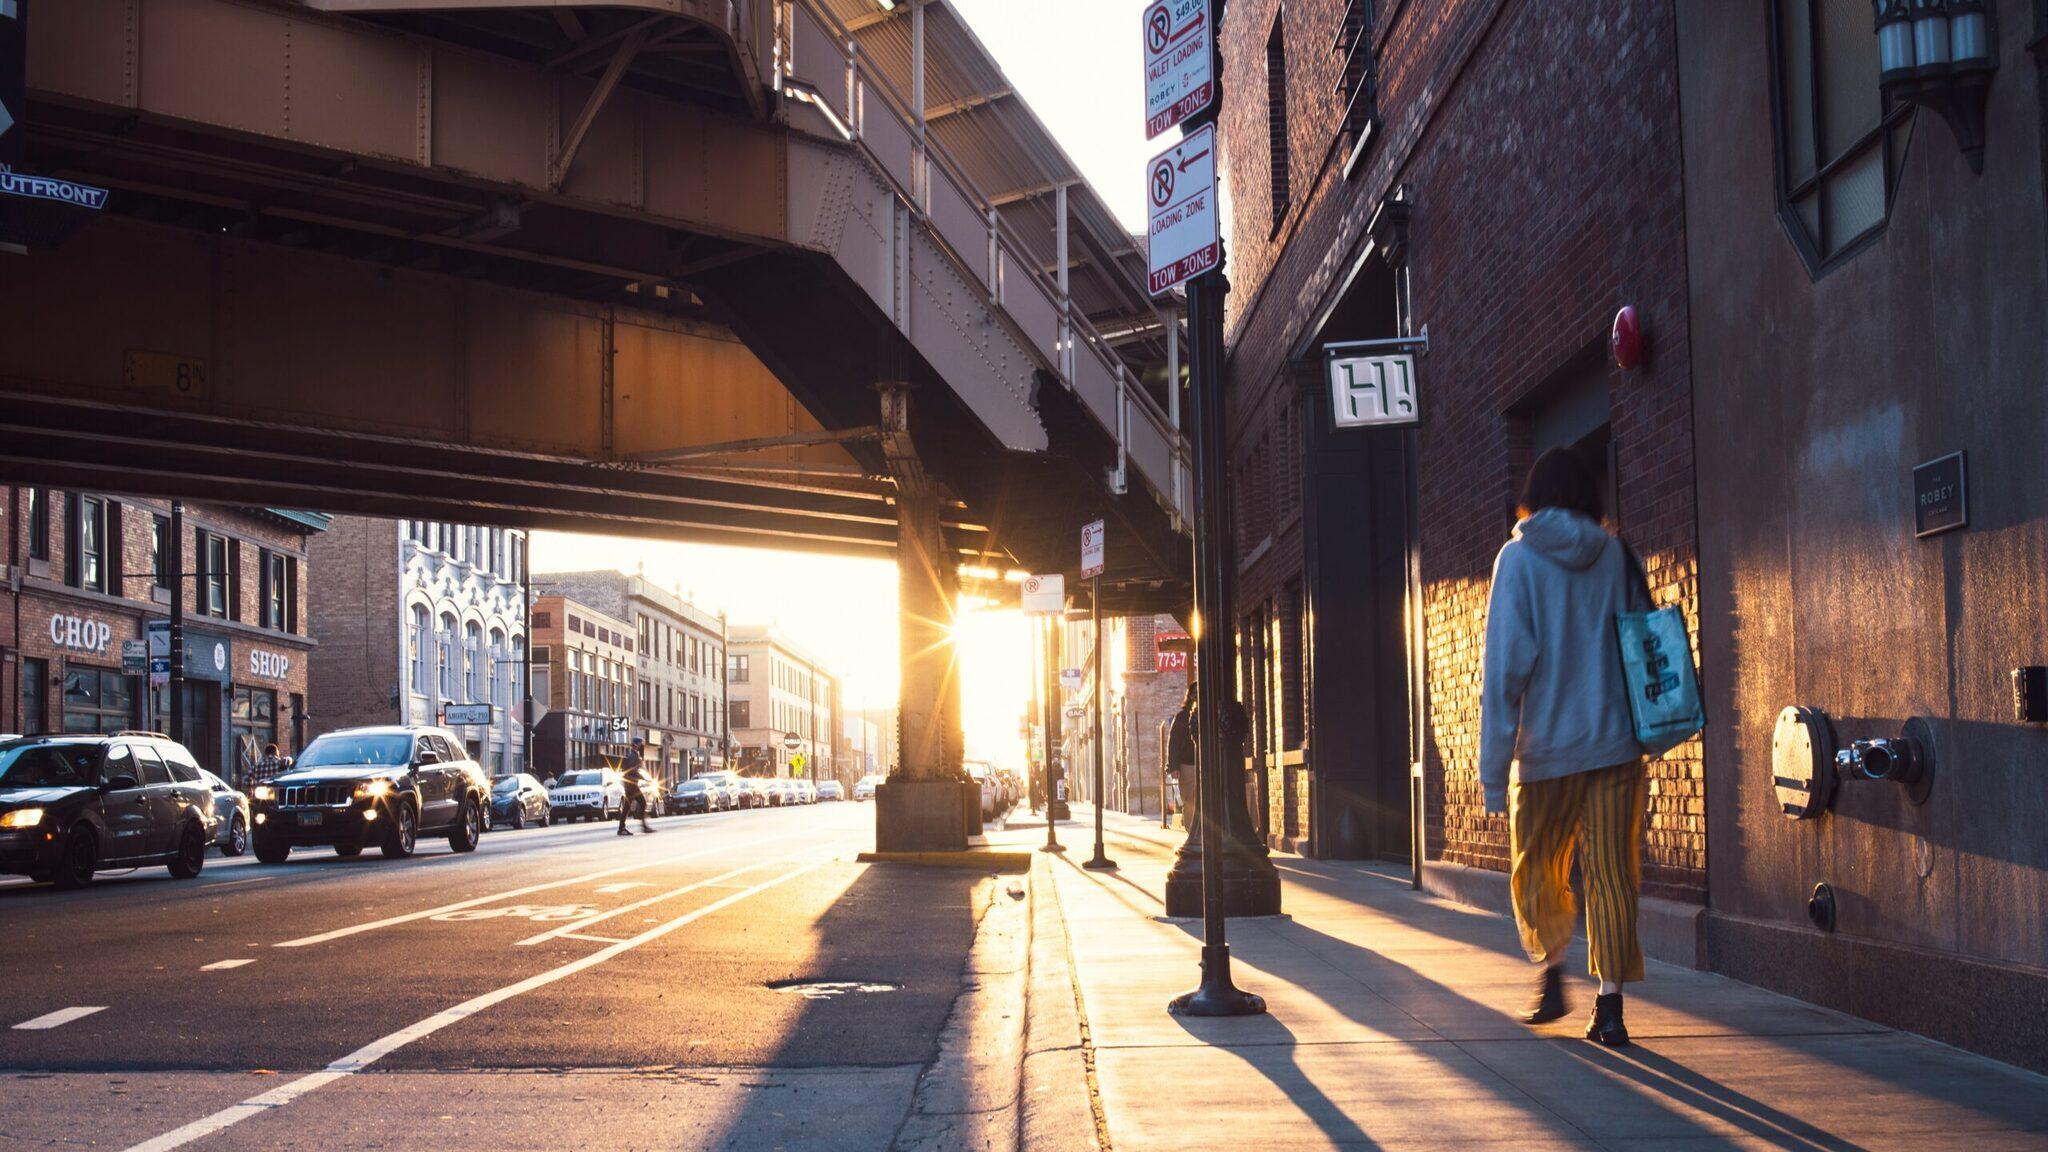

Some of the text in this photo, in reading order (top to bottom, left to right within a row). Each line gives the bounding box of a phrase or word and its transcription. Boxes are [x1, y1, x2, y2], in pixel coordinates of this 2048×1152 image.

[1149, 59, 1170, 82] VALET
[1173, 36, 1203, 67] LOADING
[1149, 86, 1206, 136] TOW ZONE
[1150, 84, 1176, 107] ROBEY
[1152, 196, 1205, 236] LOADING ZONE
[1153, 247, 1212, 290] TOW ZONE
[1920, 484, 1954, 507] ROBEY
[50, 613, 110, 651] CHOP
[250, 648, 288, 679] SHOP
[612, 718, 628, 731] 54
[614, 731, 627, 744] 11
